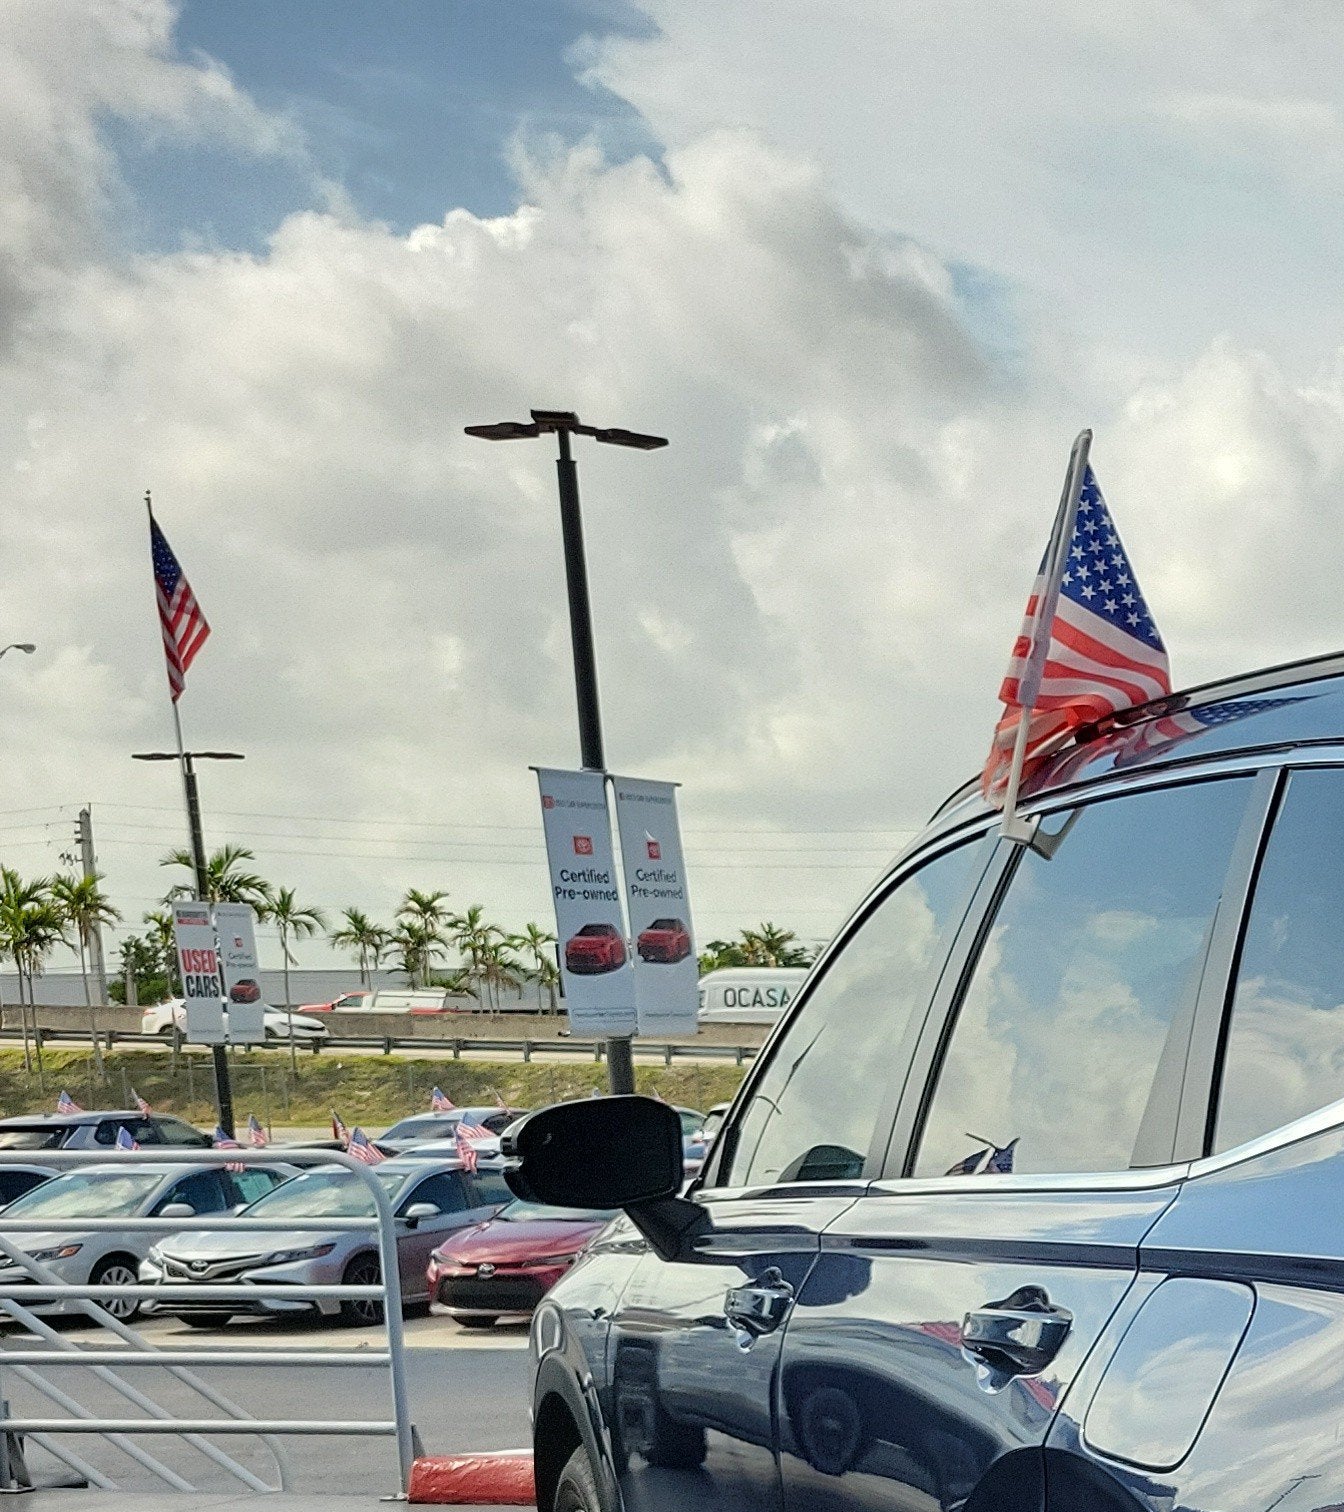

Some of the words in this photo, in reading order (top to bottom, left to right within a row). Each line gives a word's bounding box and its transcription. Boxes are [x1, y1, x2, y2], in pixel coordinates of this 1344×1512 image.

[560, 869, 610, 884] Certified
[636, 868, 677, 883] Certified
[555, 886, 618, 901] Pre-owned
[631, 885, 683, 899] Pre-owned
[181, 949, 217, 973] USED
[185, 975, 220, 998] CARS
[723, 987, 791, 1008] OCASA
